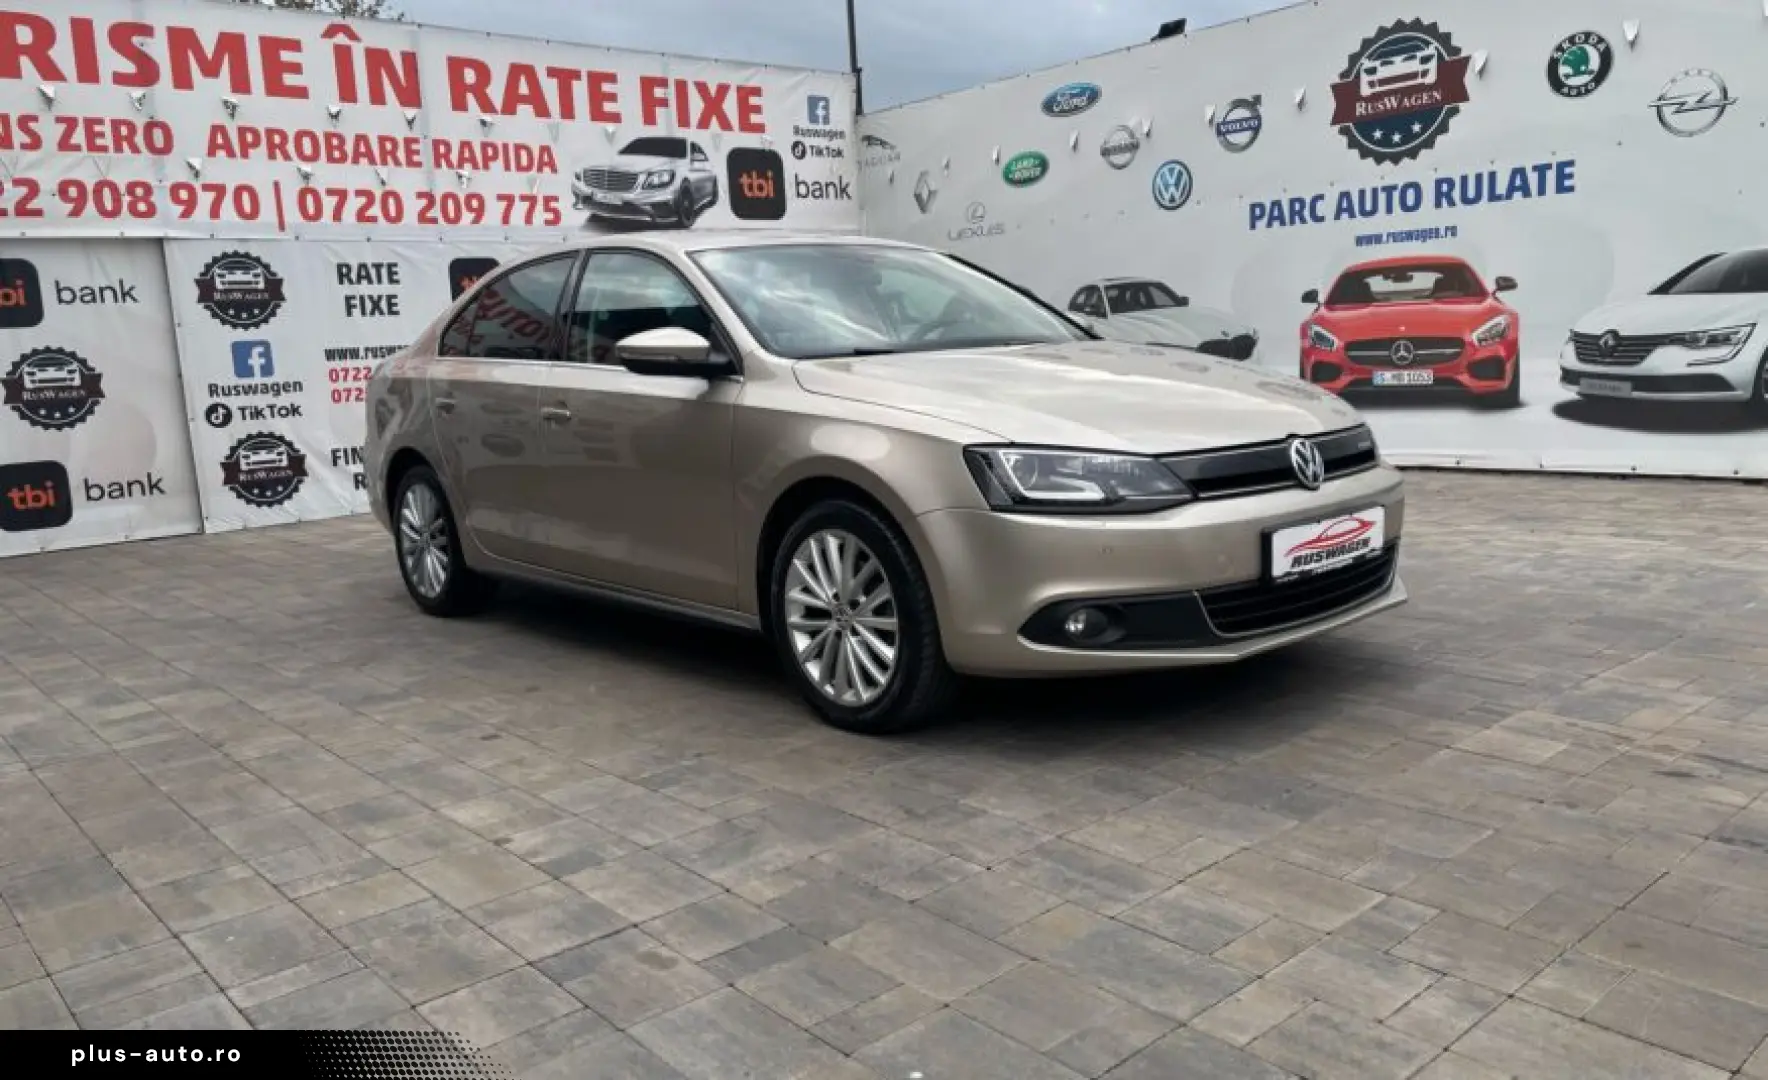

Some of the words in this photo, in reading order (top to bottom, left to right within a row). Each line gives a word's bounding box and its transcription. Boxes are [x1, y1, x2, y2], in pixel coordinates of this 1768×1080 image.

[321, 23, 423, 109] ÎN
[446, 55, 622, 124] RATE
[640, 75, 767, 134] FIXE
[1220, 118, 1259, 133] VOLVO
[55, 116, 174, 156] ZERO
[207, 124, 423, 168] APROBARE
[432, 138, 558, 174] RAPIDA
[809, 144, 845, 159] TikTok
[739, 172, 774, 199] tbi
[795, 174, 853, 200] bank
[1249, 194, 1325, 230] PARC
[1333, 179, 1421, 222] AUTO
[1435, 159, 1576, 210] RULATE
[57, 178, 157, 219] 908
[169, 181, 261, 221] 970
[297, 186, 402, 225] 0720
[416, 190, 486, 226] 209
[497, 194, 563, 227] 775
[336, 262, 400, 286] RATE
[54, 278, 140, 306] bank
[344, 294, 400, 318] FIXE
[329, 366, 372, 383] 0722
[208, 379, 304, 399] Ruswagen
[331, 387, 368, 404] 072
[237, 403, 304, 421] TikTok
[8, 481, 56, 510] tbi
[84, 472, 166, 502] bank
[1291, 536, 1371, 569] RUSWAGEN
